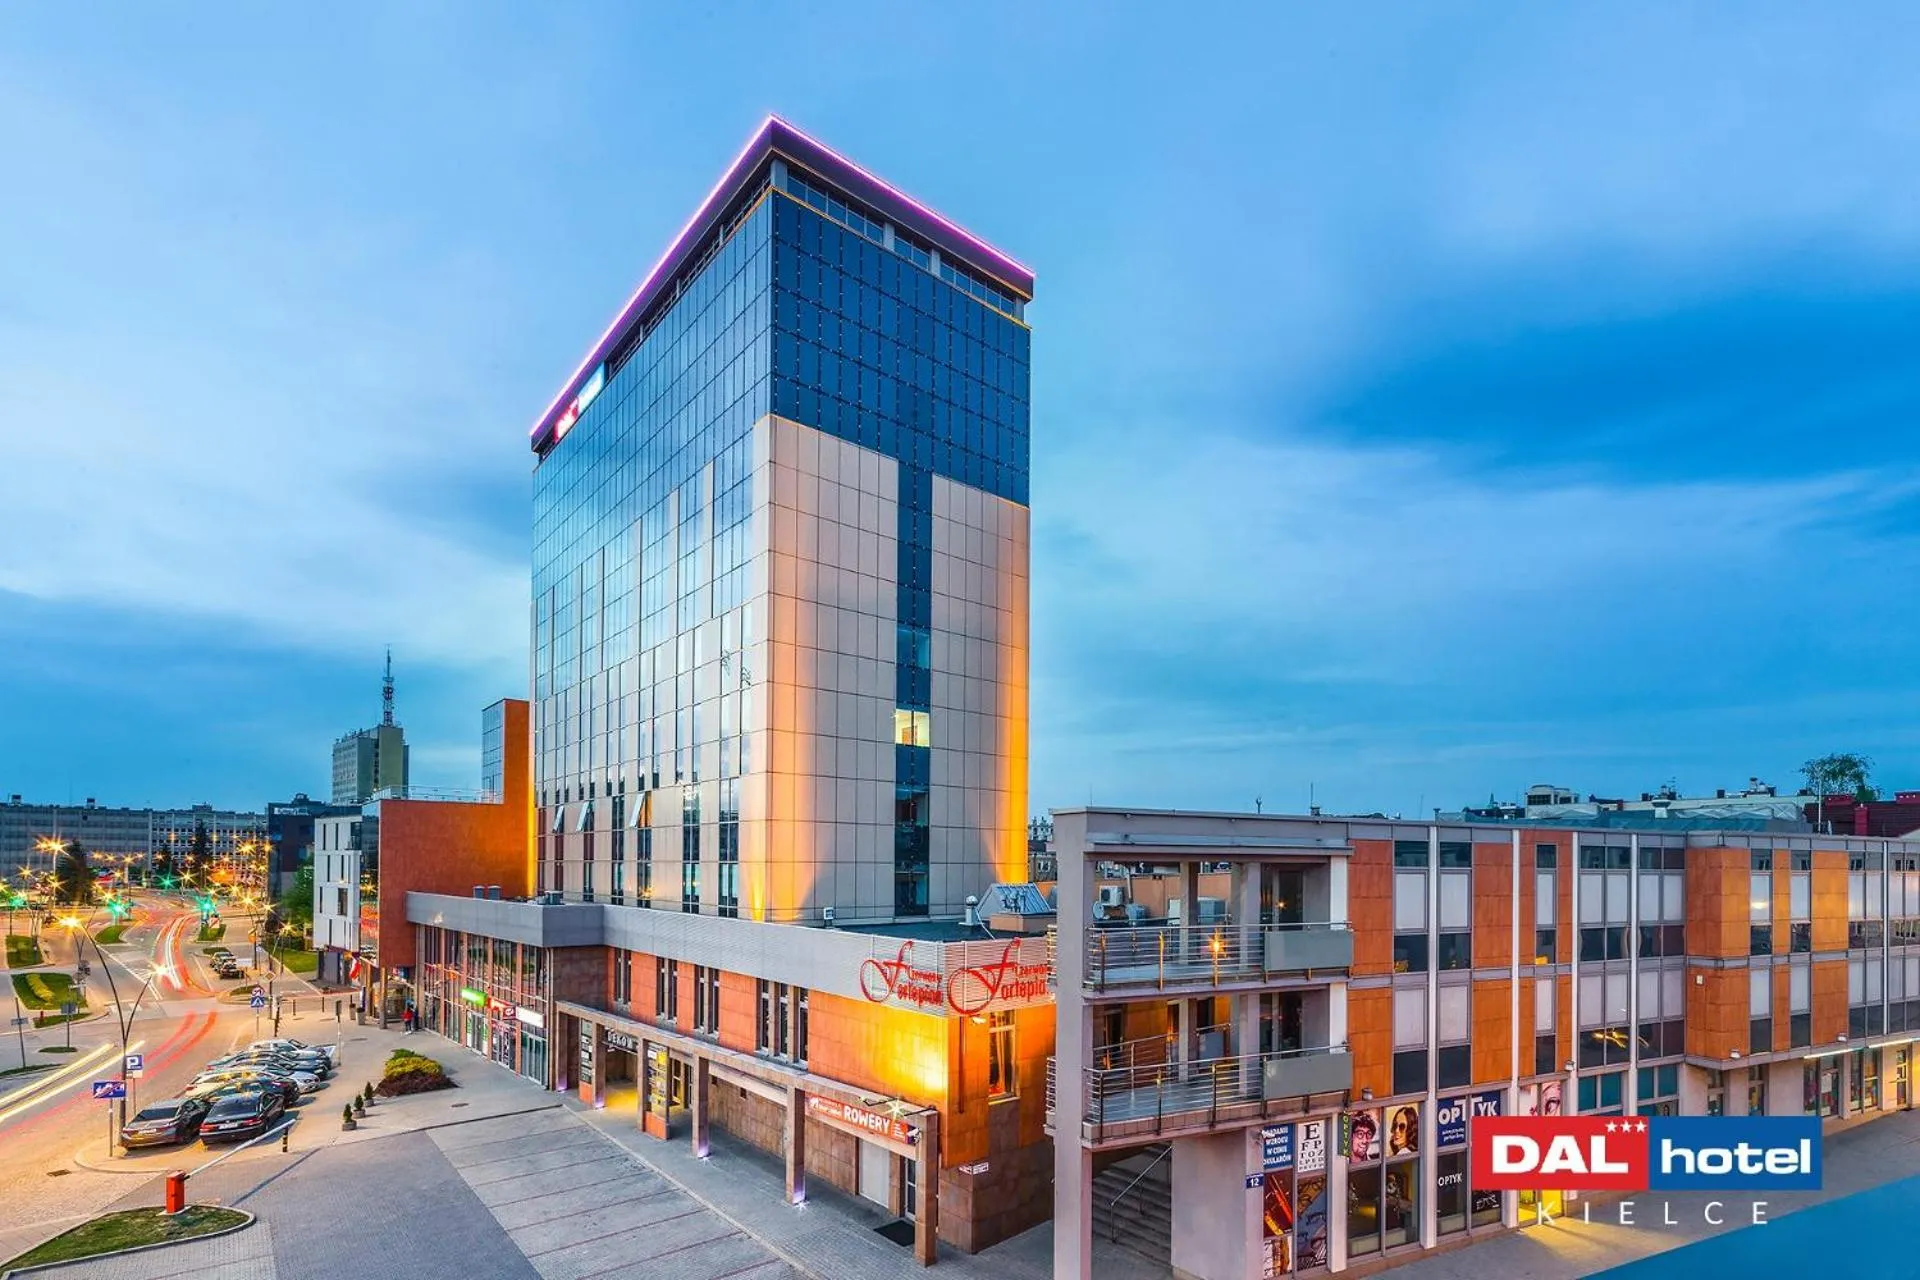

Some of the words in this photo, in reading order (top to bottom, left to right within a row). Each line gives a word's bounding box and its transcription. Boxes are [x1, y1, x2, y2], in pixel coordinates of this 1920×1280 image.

[126, 1056, 139, 1070] P
[1438, 1096, 1497, 1125] OPTYK
[843, 1105, 891, 1135] ROWERY
[1304, 1123, 1319, 1140] E
[1250, 1178, 1260, 1187] 12
[1438, 1172, 1462, 1187] OPTYK
